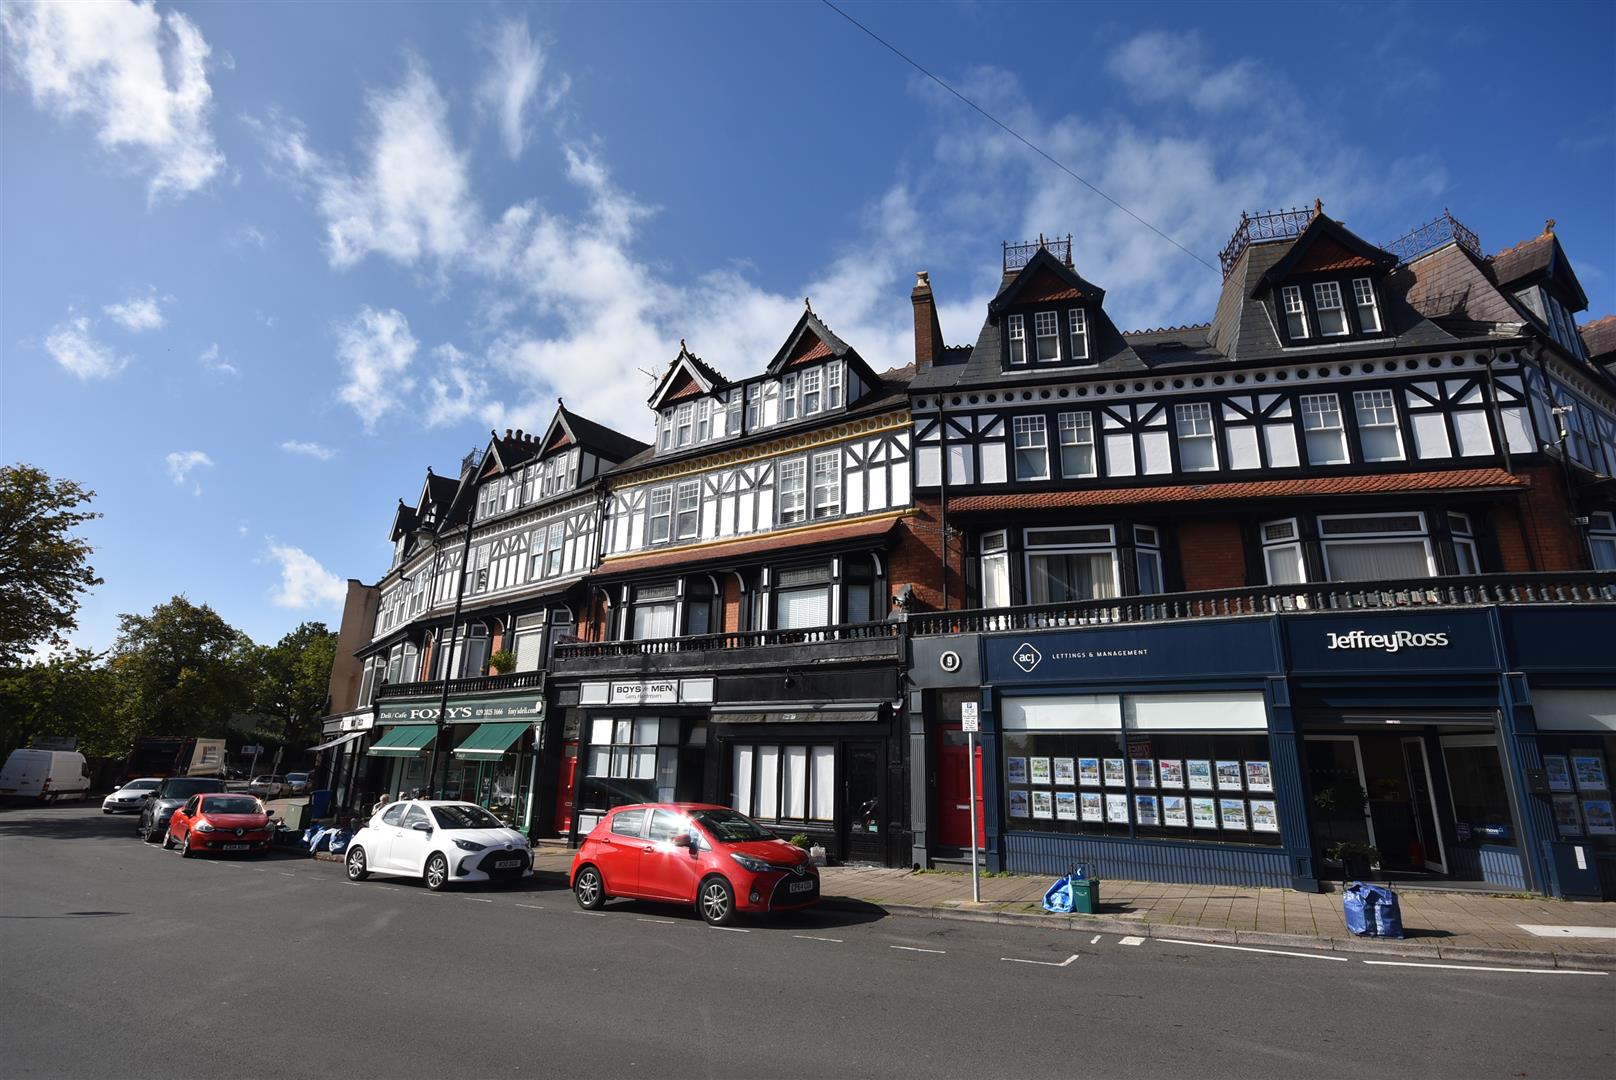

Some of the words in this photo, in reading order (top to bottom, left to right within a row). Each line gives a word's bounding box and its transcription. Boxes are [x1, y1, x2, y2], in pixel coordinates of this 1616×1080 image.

[1052, 651, 1086, 660] LETTINGS
[1096, 649, 1148, 657] MANAGEMENT
[947, 656, 953, 666] 9
[616, 685, 641, 693] BOYS
[651, 684, 673, 692] MEN
